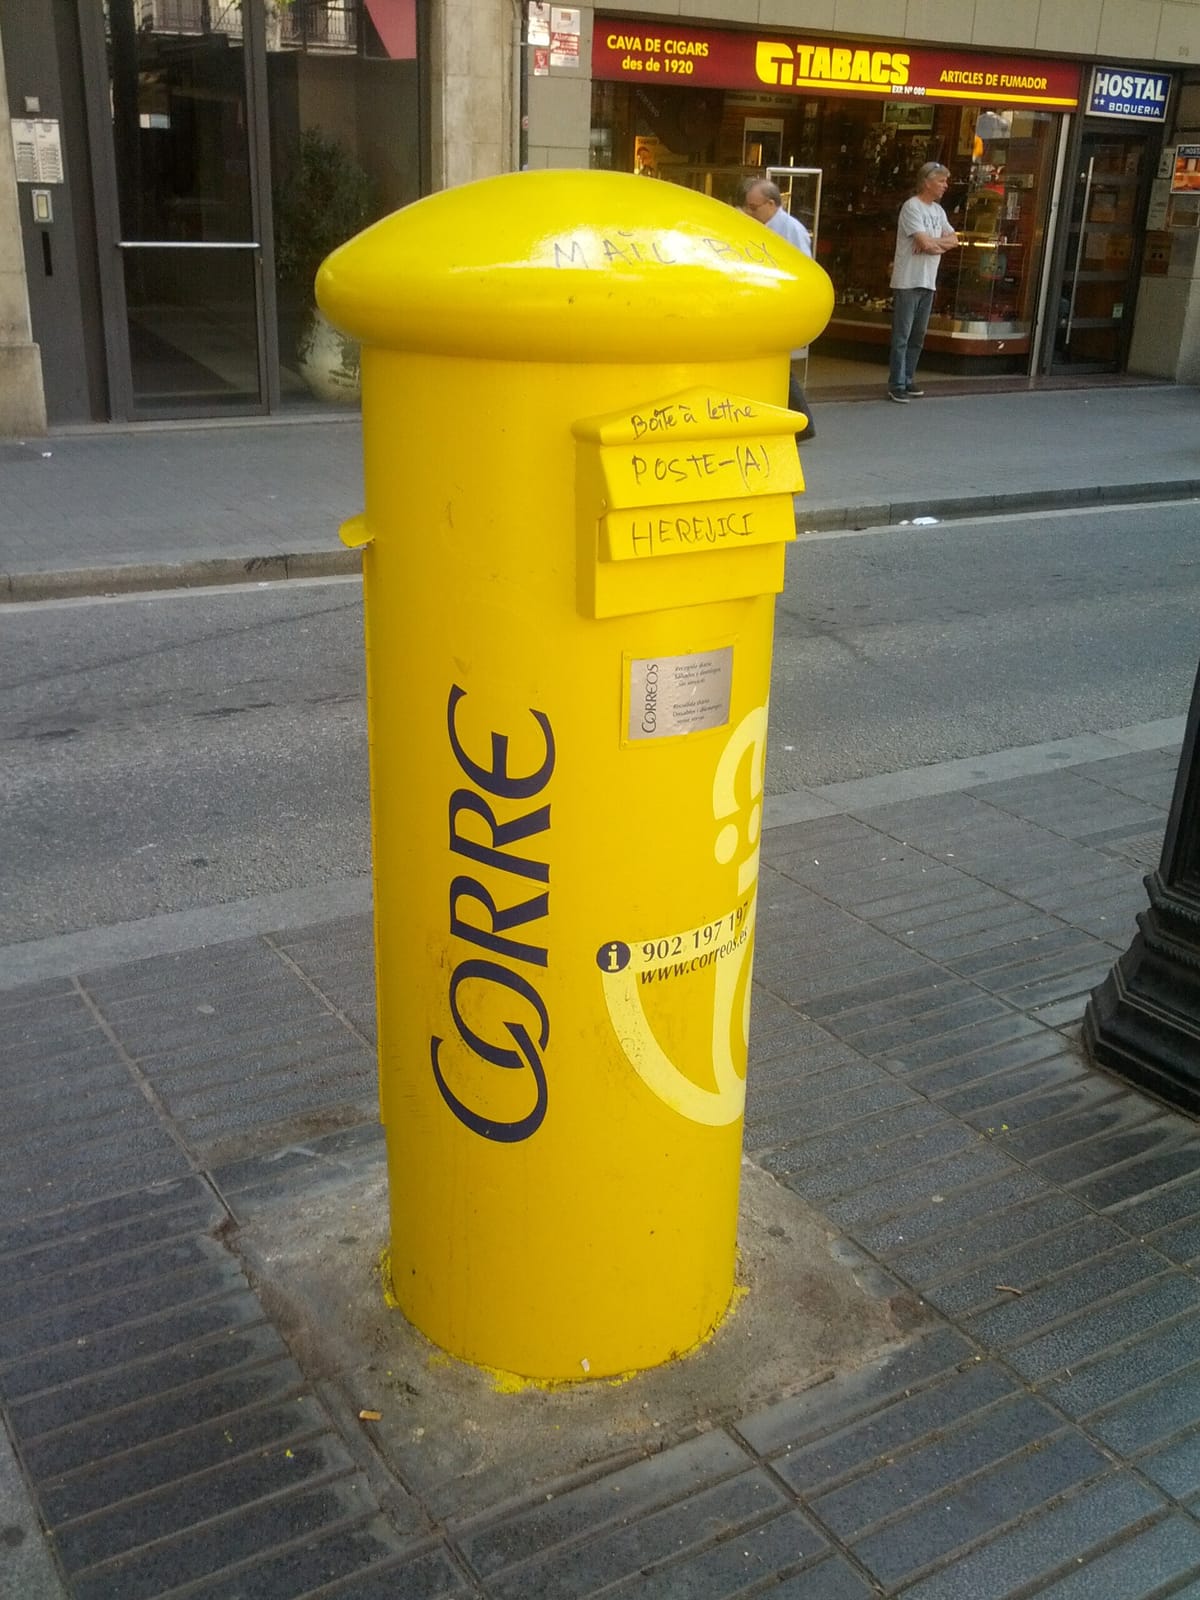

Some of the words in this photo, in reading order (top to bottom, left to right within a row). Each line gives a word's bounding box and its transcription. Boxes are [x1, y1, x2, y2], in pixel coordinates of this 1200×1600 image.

[606, 35, 642, 52] CAVA
[645, 38, 661, 53] DE
[664, 40, 709, 57] CIGARS
[622, 56, 643, 71] des
[645, 57, 661, 72] de
[664, 59, 694, 74] 1920
[796, 44, 910, 84] TABACS
[940, 69, 984, 86] ARTICLES
[985, 73, 998, 86] DE
[999, 73, 1048, 90] FUMADOR
[1094, 73, 1166, 102] HOSTAL
[1108, 102, 1161, 116] BOQUERIA
[641, 663, 659, 734] CORREOS
[430, 683, 556, 1143] CORRE
[642, 936, 683, 963] 902
[692, 920, 723, 949] 197
[729, 900, 750, 932] 197
[640, 926, 750, 985] www.correos.es
